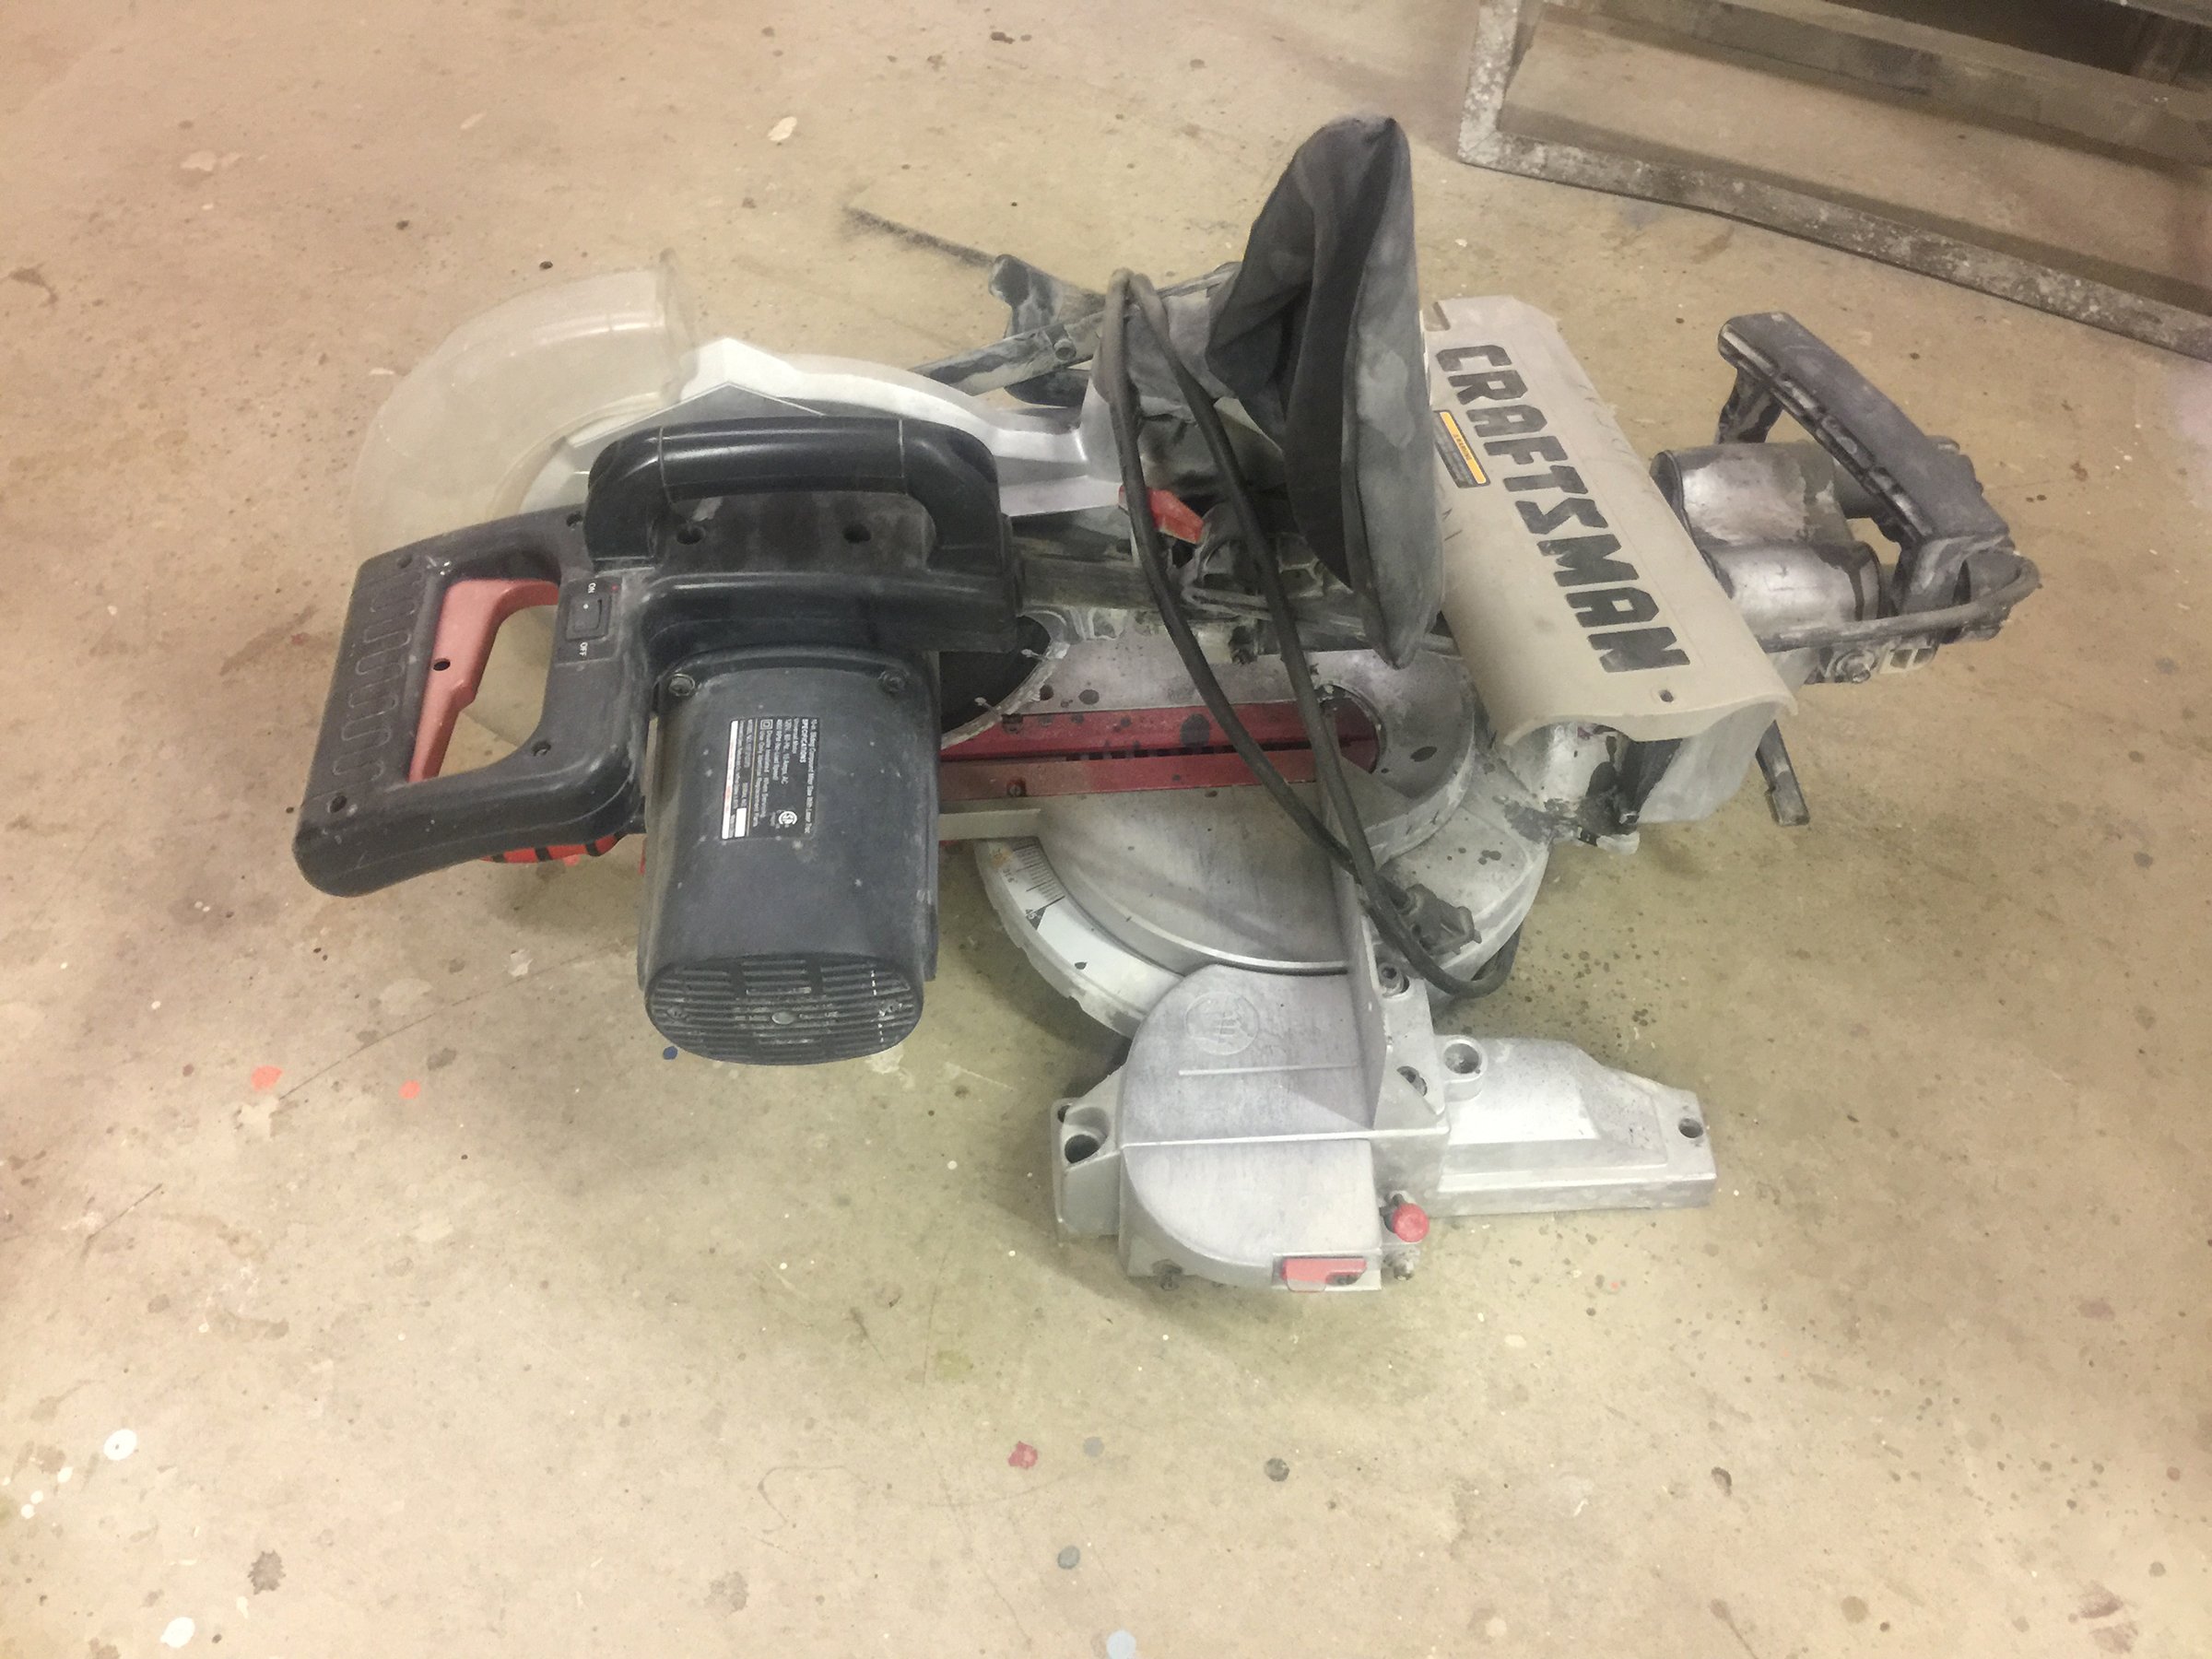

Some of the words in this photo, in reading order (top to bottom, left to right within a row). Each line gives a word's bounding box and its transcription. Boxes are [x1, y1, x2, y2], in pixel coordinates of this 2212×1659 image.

[1436, 344, 1690, 673] CRAFTSMAN
[588, 582, 596, 594] ON
[579, 642, 588, 656] OFF
[799, 718, 809, 763] SPECIFICATIONS
[807, 747, 817, 773] Compound
